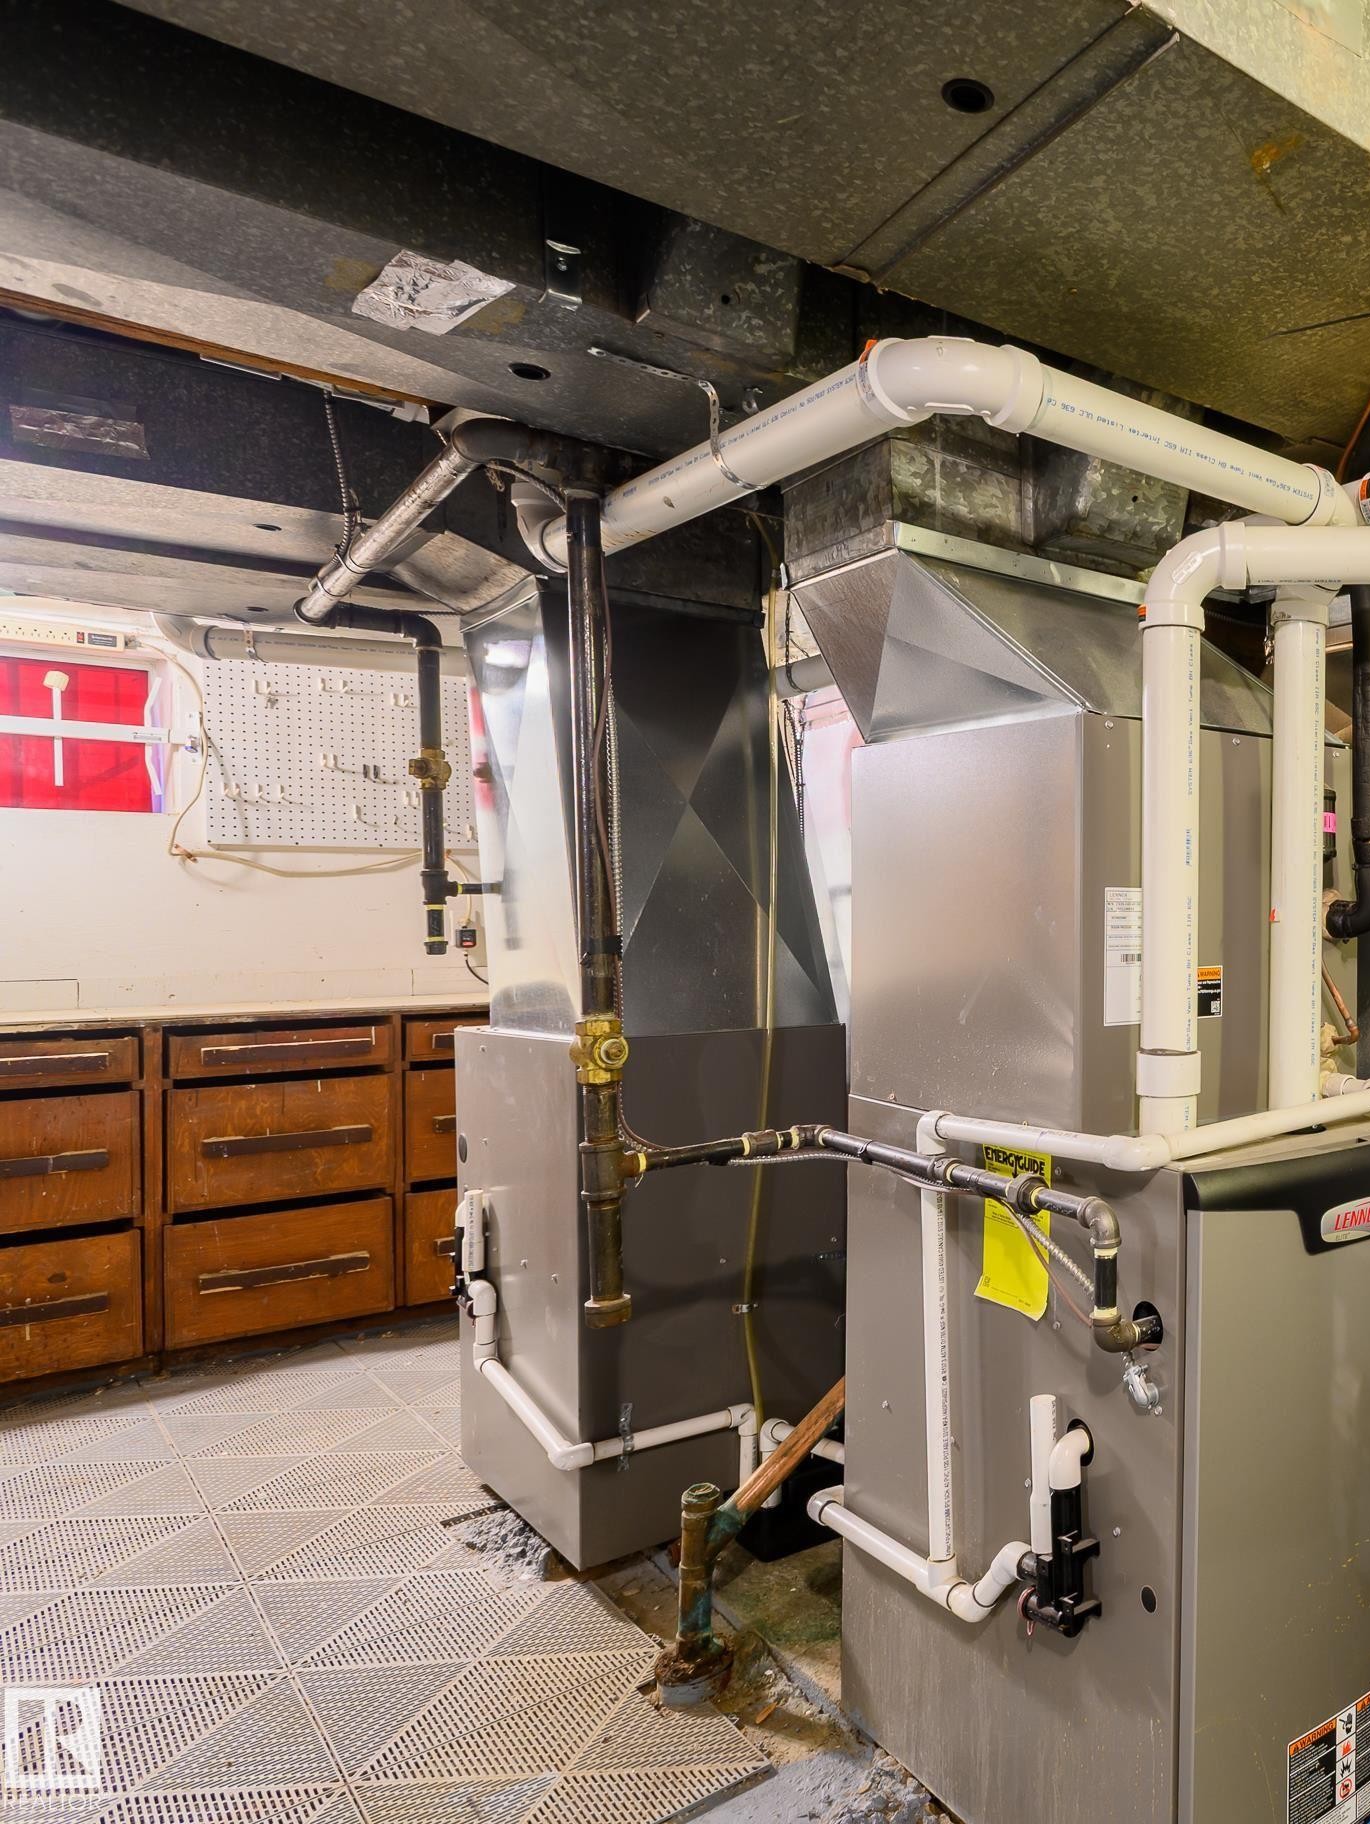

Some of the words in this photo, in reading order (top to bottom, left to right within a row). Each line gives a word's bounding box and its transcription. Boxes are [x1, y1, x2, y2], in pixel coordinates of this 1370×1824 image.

[1076, 407, 1094, 420] ULC
[1095, 414, 1125, 432] Listed
[1194, 451, 1216, 465] Class
[1290, 486, 1314, 500] SYSTEM
[1299, 1721, 1335, 1747] WARNING
